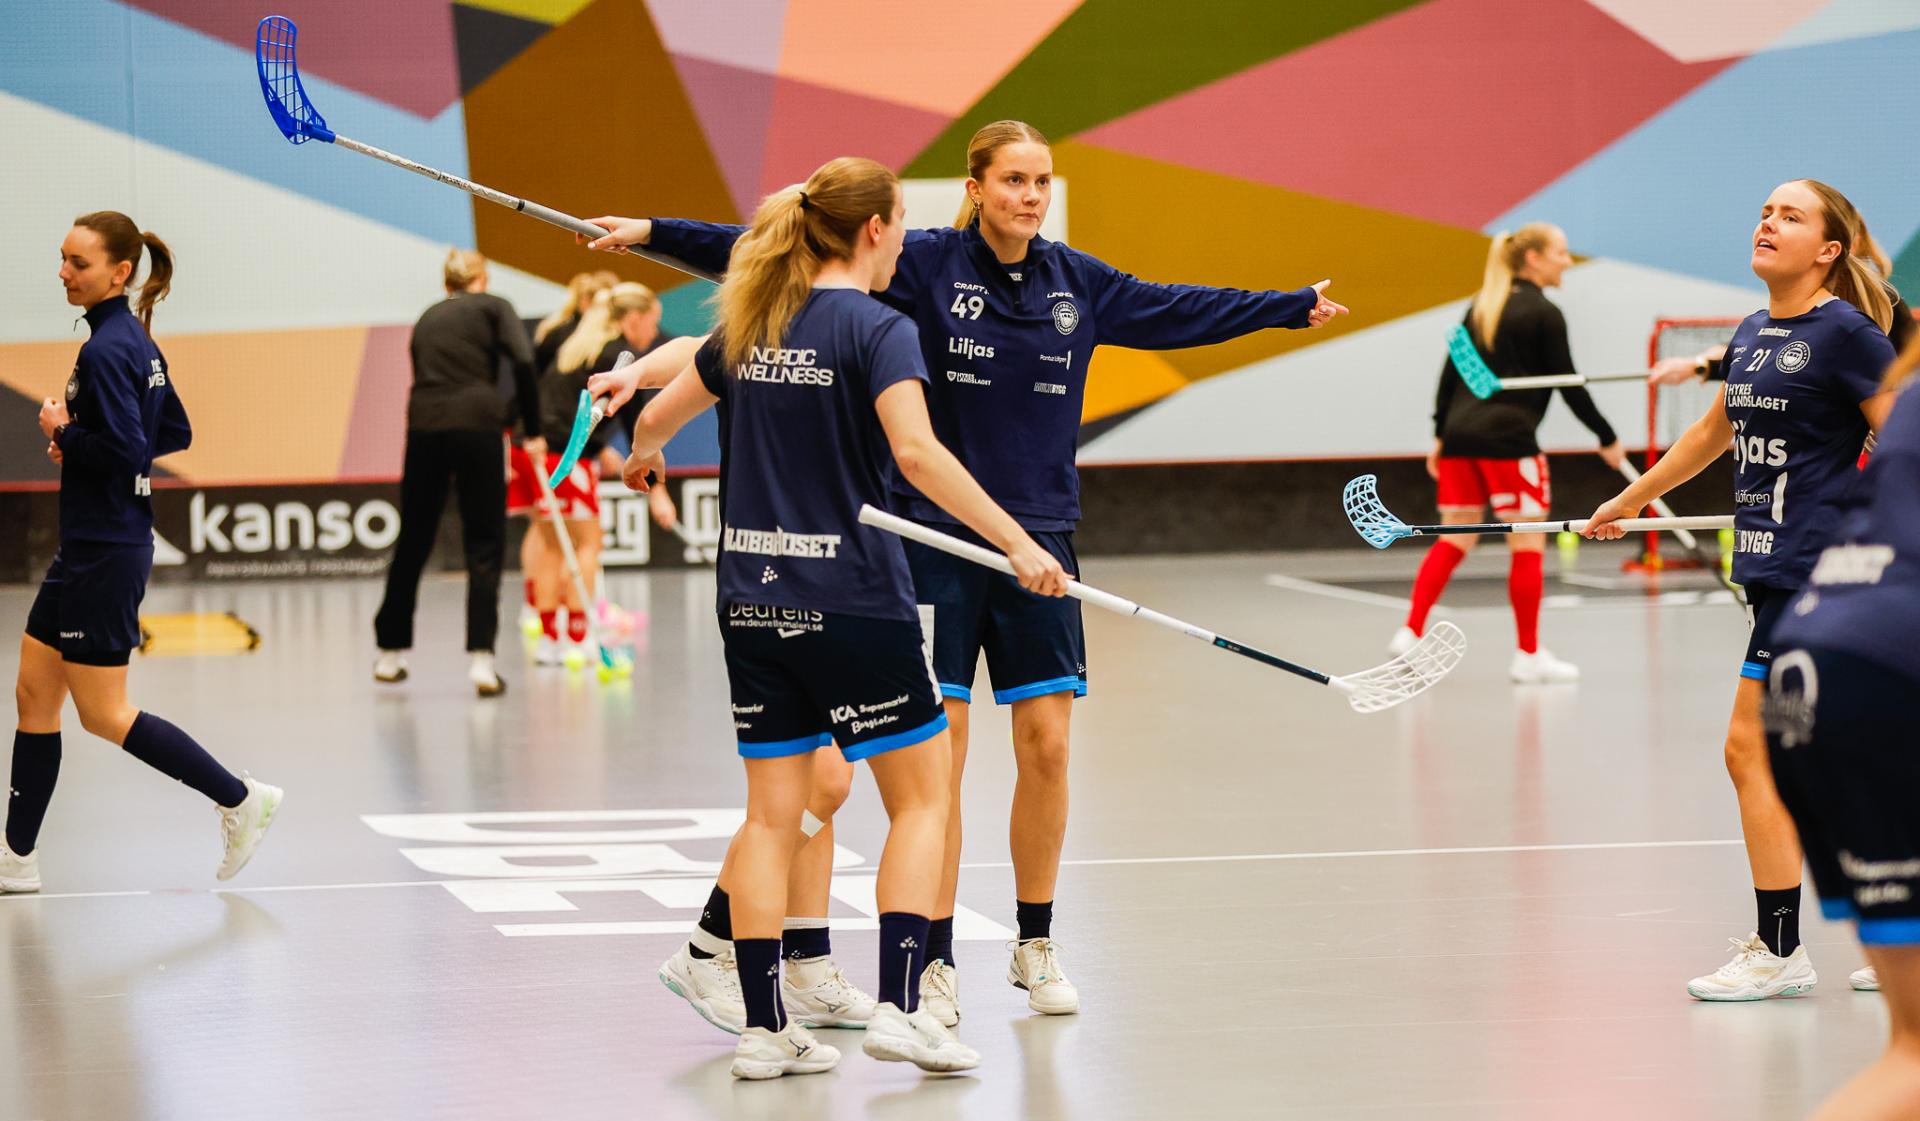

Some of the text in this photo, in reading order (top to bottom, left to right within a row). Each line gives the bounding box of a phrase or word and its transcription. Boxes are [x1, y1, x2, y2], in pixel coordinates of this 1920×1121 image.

[953, 281, 985, 293] CRAFT
[950, 293, 985, 321] 49
[749, 345, 817, 366] NORDIC
[948, 337, 995, 360] Liljas
[1744, 348, 1772, 372] 21
[737, 364, 834, 387] WELLNESS
[1728, 383, 1753, 396] HYRES
[1727, 395, 1789, 412] LANDSLAGET
[189, 490, 401, 553] kanso
[829, 693, 910, 724] ICA Supermarket
[851, 714, 900, 735] Borgholm
